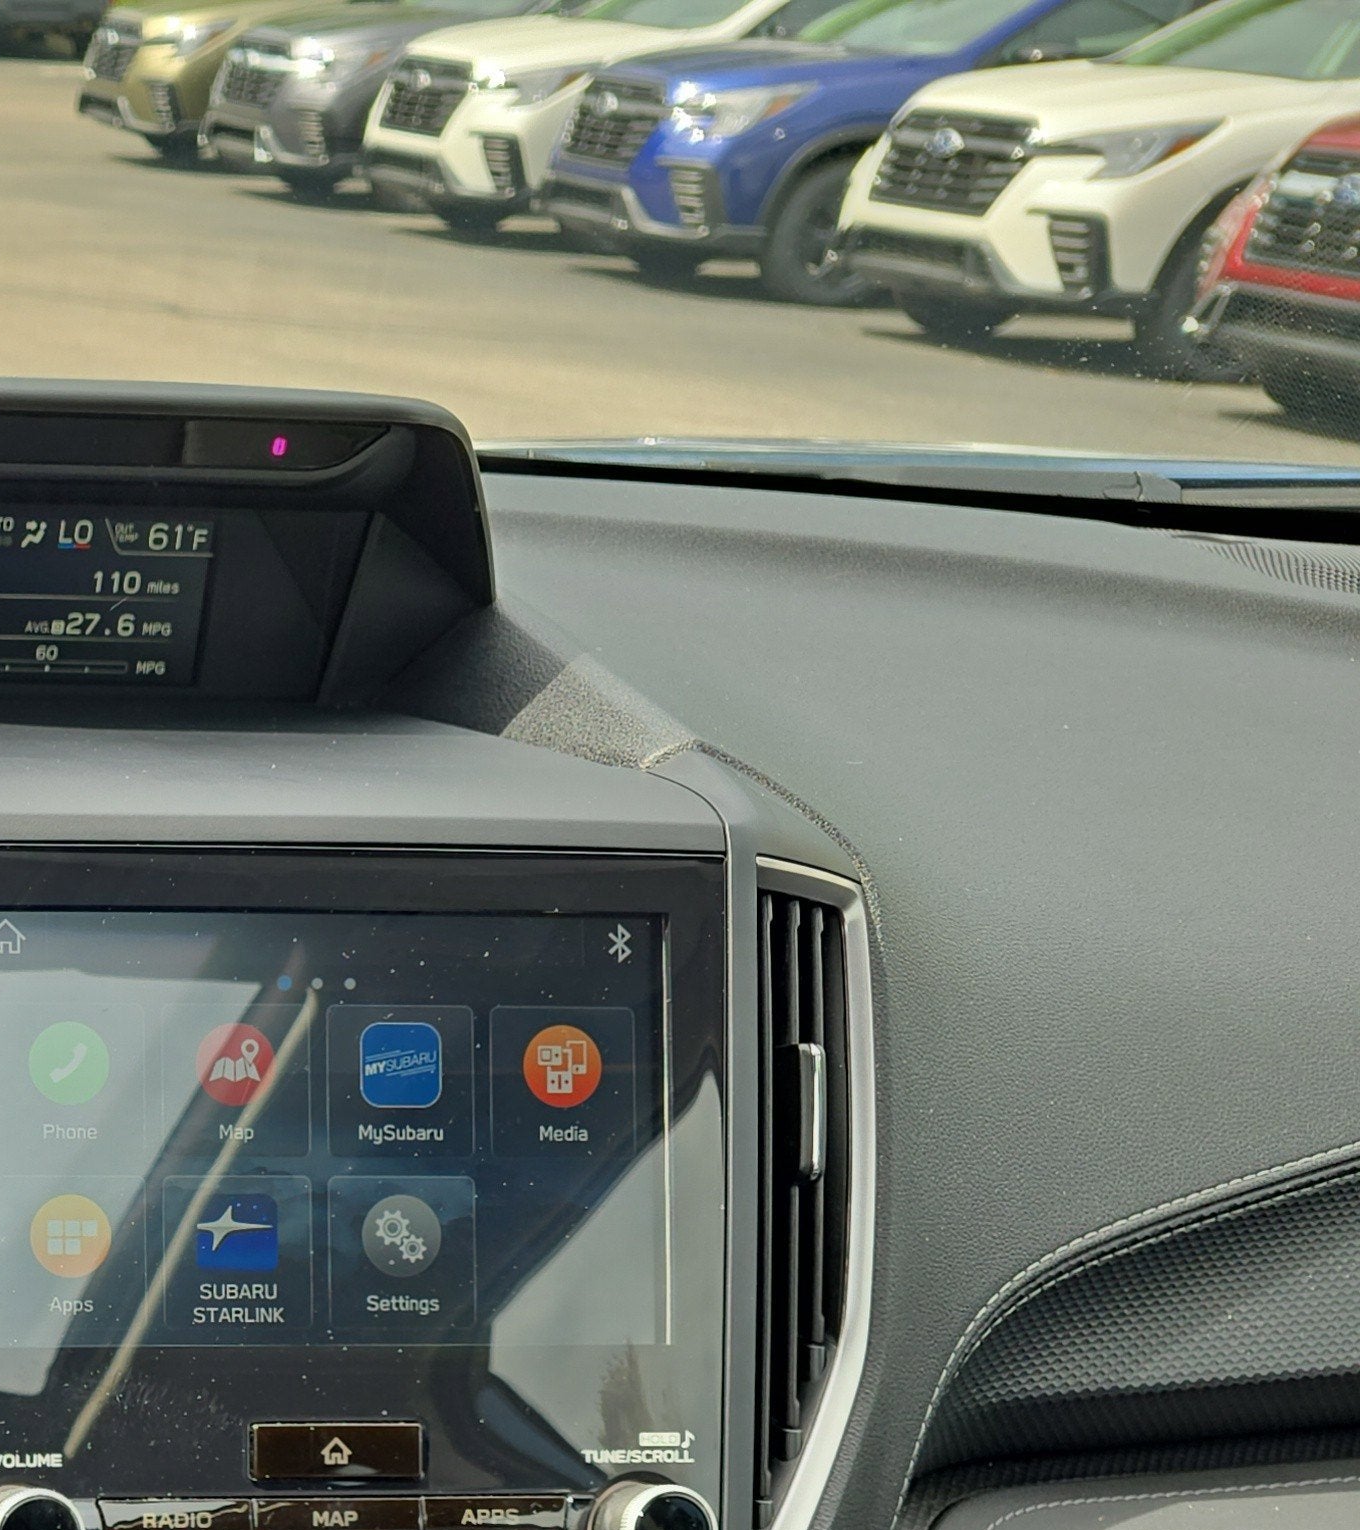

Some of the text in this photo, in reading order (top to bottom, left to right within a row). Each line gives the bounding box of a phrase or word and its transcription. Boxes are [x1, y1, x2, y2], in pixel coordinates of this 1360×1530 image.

[59, 519, 94, 545] LO
[93, 570, 179, 595] 110 miles
[66, 611, 136, 637] 27.6
[141, 621, 173, 637] MPG
[36, 643, 59, 661] 60
[135, 660, 166, 676] MPG
[364, 1050, 438, 1077] MYSUBARU
[42, 1122, 98, 1141] Phone
[218, 1122, 255, 1145] Map
[357, 1123, 445, 1145] MySubaru
[538, 1124, 589, 1143] Media
[199, 1283, 278, 1301] SUBARU
[49, 1295, 95, 1316] Apps
[366, 1294, 441, 1315] Settings
[192, 1305, 285, 1324] STARLINK
[581, 1449, 695, 1464] TUNE/SCROLL
[141, 1512, 213, 1530] RADIO
[311, 1509, 359, 1529] MAP
[460, 1508, 520, 1527] APPS
